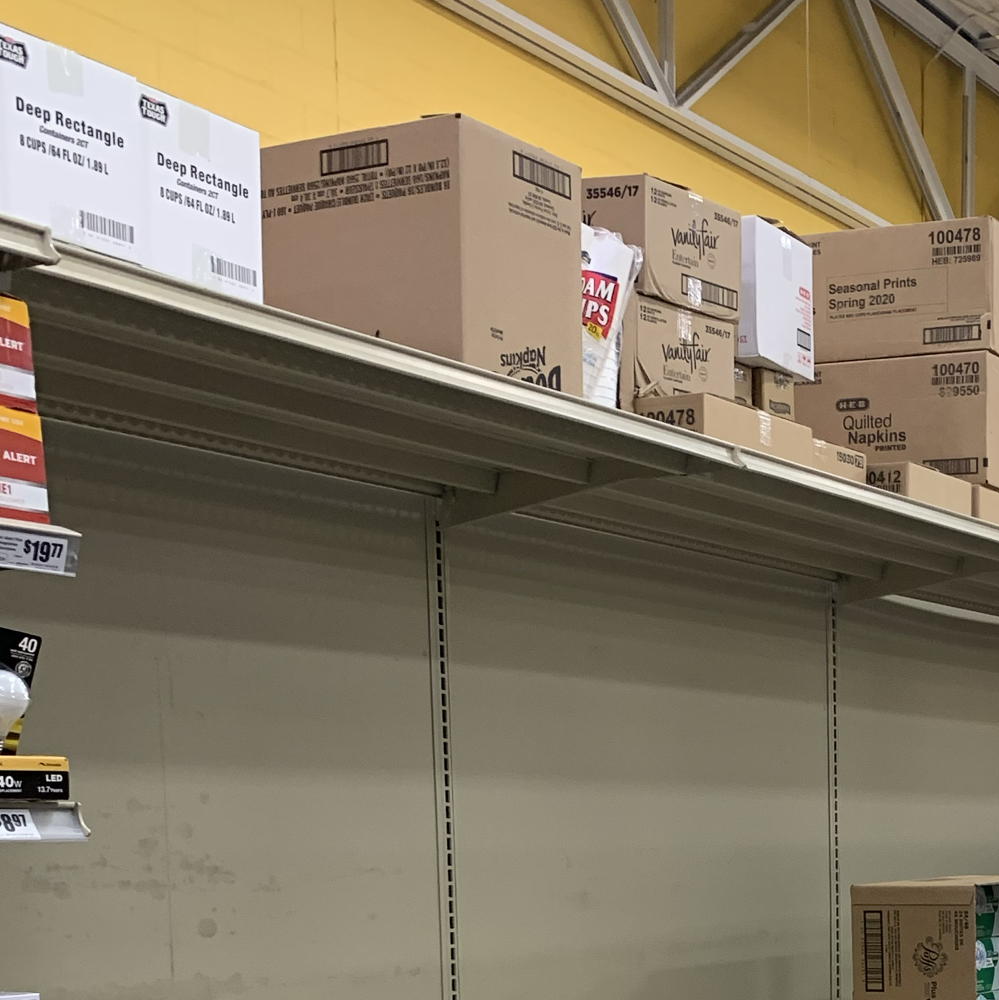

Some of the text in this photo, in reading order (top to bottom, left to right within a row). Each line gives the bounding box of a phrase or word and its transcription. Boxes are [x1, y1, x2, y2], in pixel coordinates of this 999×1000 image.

[141, 106, 166, 122] TOUGH
[142, 98, 164, 114] TEXAS
[16, 96, 124, 148] Deep Rectangle
[40, 126, 88, 148] Containers 2CT
[20, 134, 24, 146] 8
[26, 136, 46, 154] CUPS
[63, 149, 71, 162] FL
[87, 158, 102, 173] 1.89
[104, 163, 109, 175] L
[158, 152, 248, 198] Deep Rectangle
[177, 178, 218, 199] Containers 2CT
[586, 186, 639, 200] 35546/17
[160, 187, 164, 198] 8
[166, 188, 182, 204] CUPS
[196, 200, 204, 212] FL
[217, 208, 230, 222] 1.89
[232, 213, 236, 224] L
[714, 212, 739, 228] 35546/17
[928, 227, 981, 245] 100478
[828, 277, 918, 294] Seasonal Prints
[828, 294, 896, 311] Spring 2020
[705, 326, 730, 339] 35546/17
[0, 337, 24, 352] LERT
[500, 346, 546, 368] Napkins
[932, 362, 980, 376] 100470
[639, 408, 695, 426] 0478
[843, 413, 892, 431] Quilted
[848, 430, 906, 447] Napkins
[2, 450, 37, 466] ALERT
[866, 470, 900, 485] 0412
[18, 637, 38, 652] 40
[46, 774, 62, 782] LED
[0, 812, 26, 832] 897
[920, 946, 940, 972] Puffs
